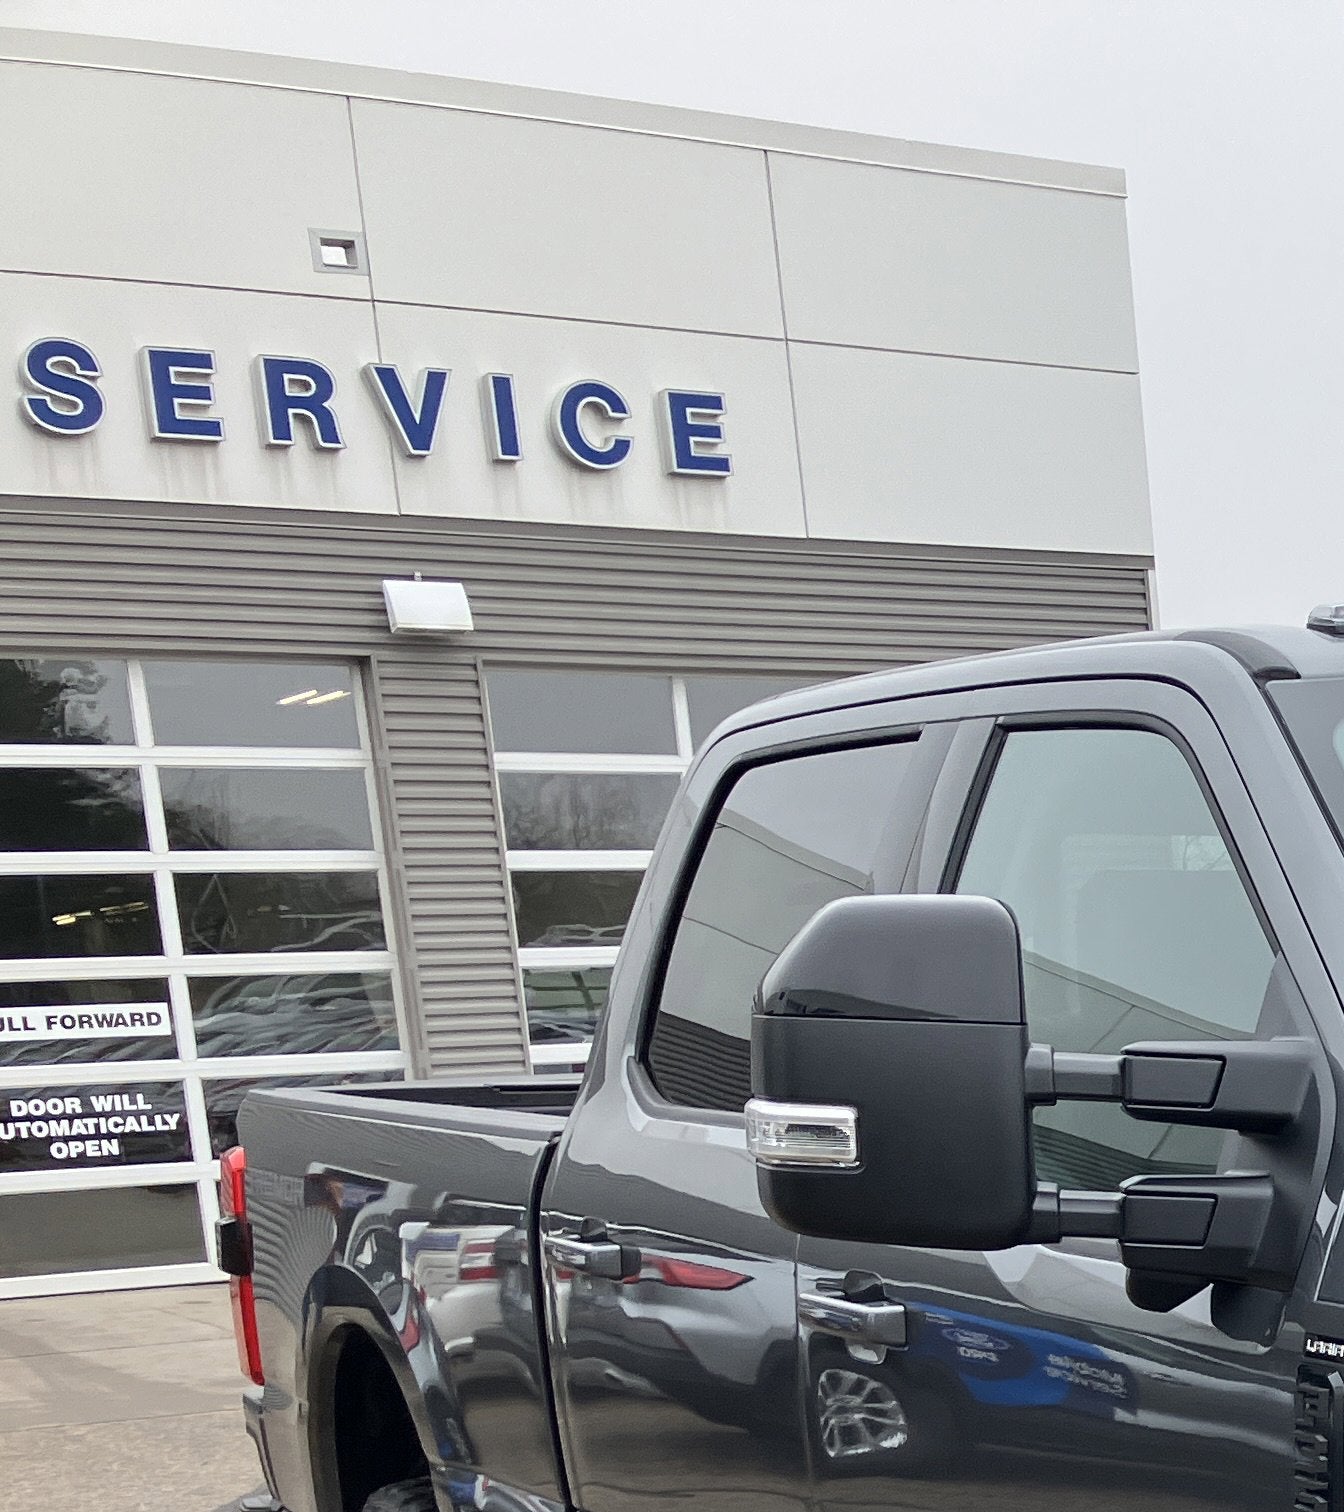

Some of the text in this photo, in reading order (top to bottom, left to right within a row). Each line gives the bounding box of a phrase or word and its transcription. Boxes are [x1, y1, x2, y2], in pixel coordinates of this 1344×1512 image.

[20, 336, 734, 478] SERVICE
[46, 1011, 162, 1031] FORWARD
[10, 1093, 152, 1117] DOOR WILL
[0, 1113, 181, 1140] UTOMATICALLY
[50, 1138, 120, 1159] OPEN
